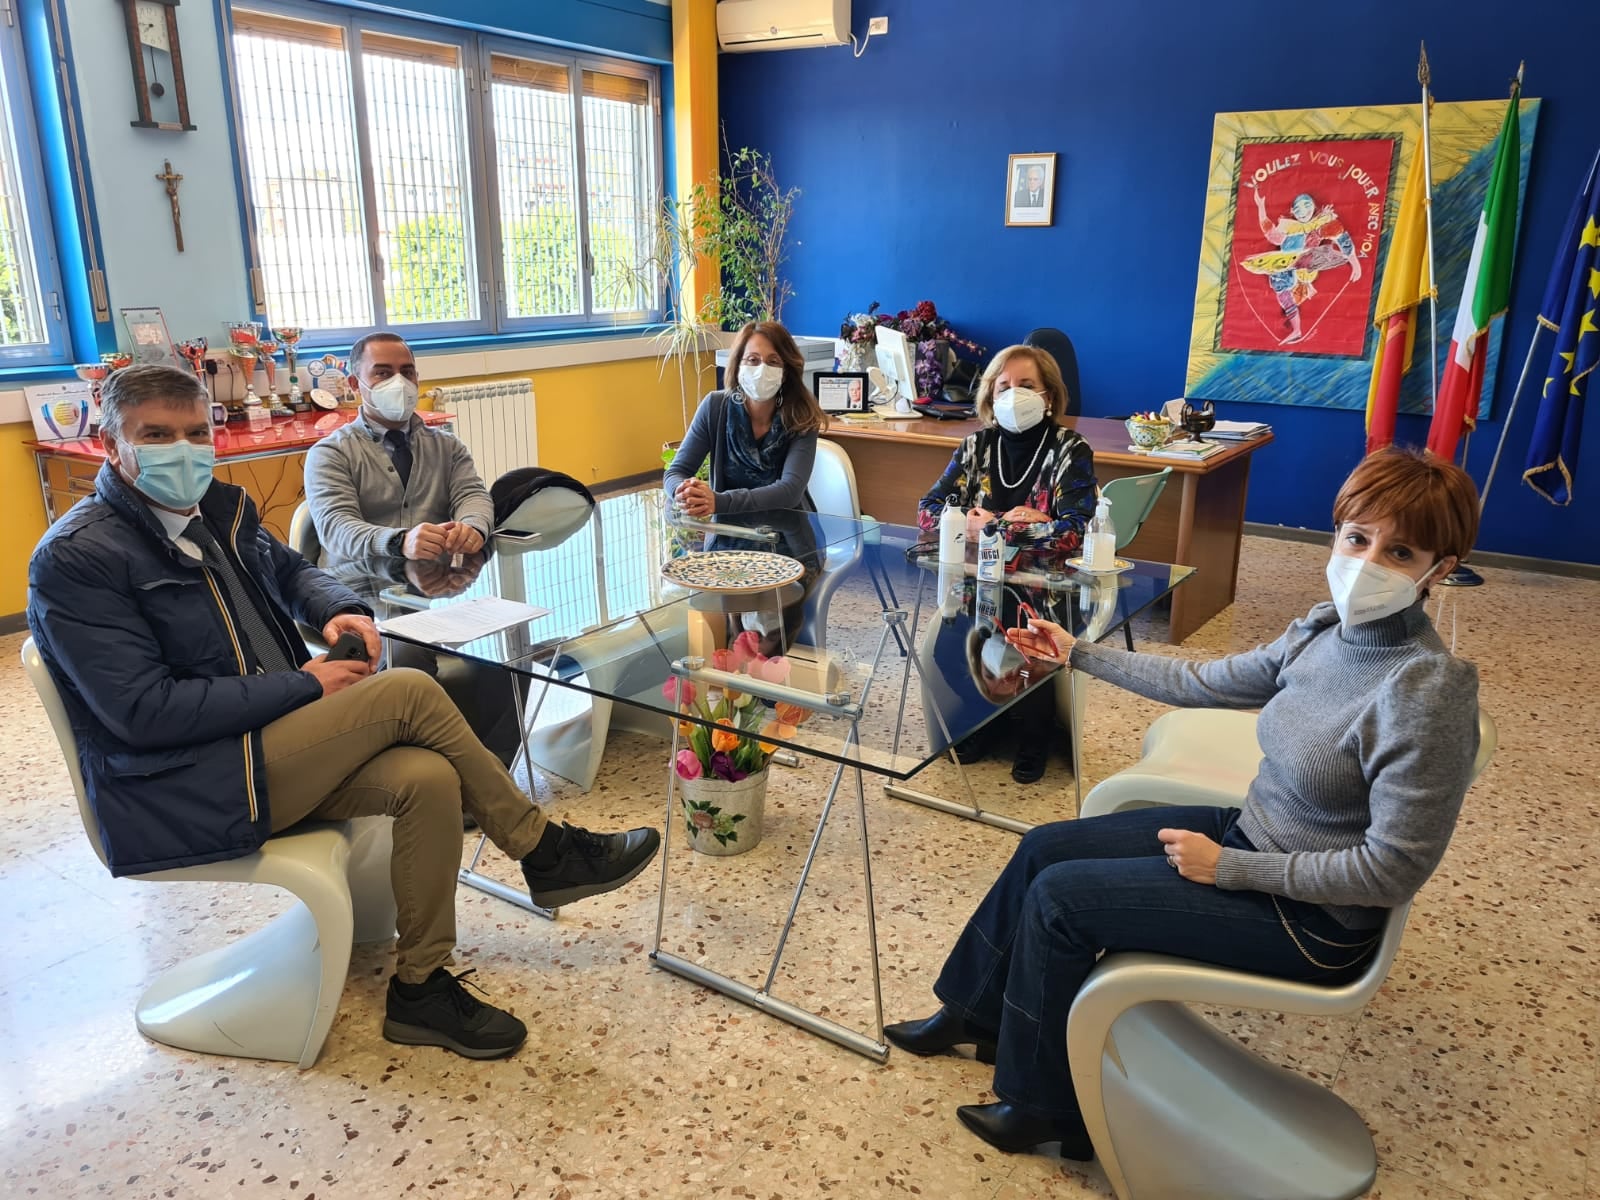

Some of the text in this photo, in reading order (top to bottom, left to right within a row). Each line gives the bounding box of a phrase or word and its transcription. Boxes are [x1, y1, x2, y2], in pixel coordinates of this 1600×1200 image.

[1243, 152, 1301, 189] VOULEZ
[1308, 150, 1344, 168] VOUS
[1338, 164, 1380, 199] JOUER
[1367, 202, 1380, 230] AVEC
